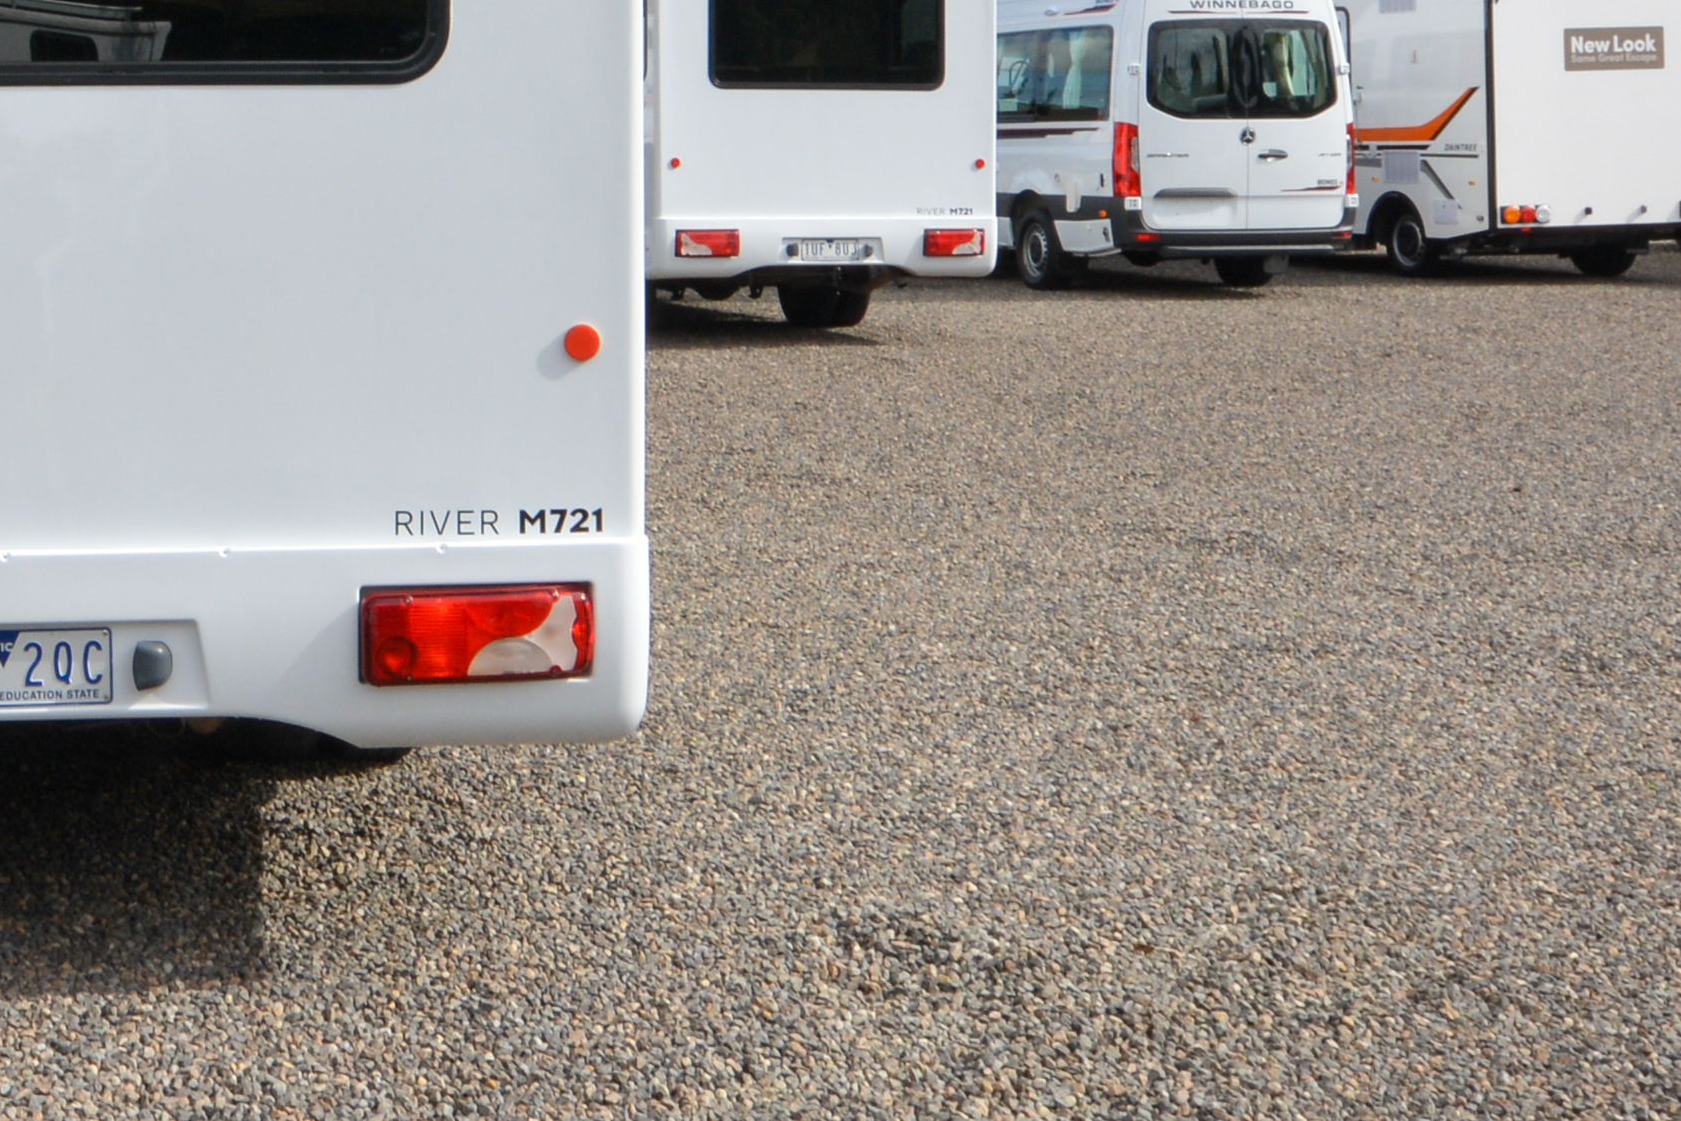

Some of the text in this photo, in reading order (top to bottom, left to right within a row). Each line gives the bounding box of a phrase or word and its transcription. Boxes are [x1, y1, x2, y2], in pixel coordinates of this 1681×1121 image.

[1189, 0, 1294, 9] WINNEBAGO
[1570, 33, 1657, 54] New Look
[917, 207, 973, 216] RIVER M721
[394, 508, 603, 536] RIVER M721
[23, 640, 104, 687] 2QC
[0, 690, 66, 701] EDUCATION
[67, 688, 100, 699] STATE
